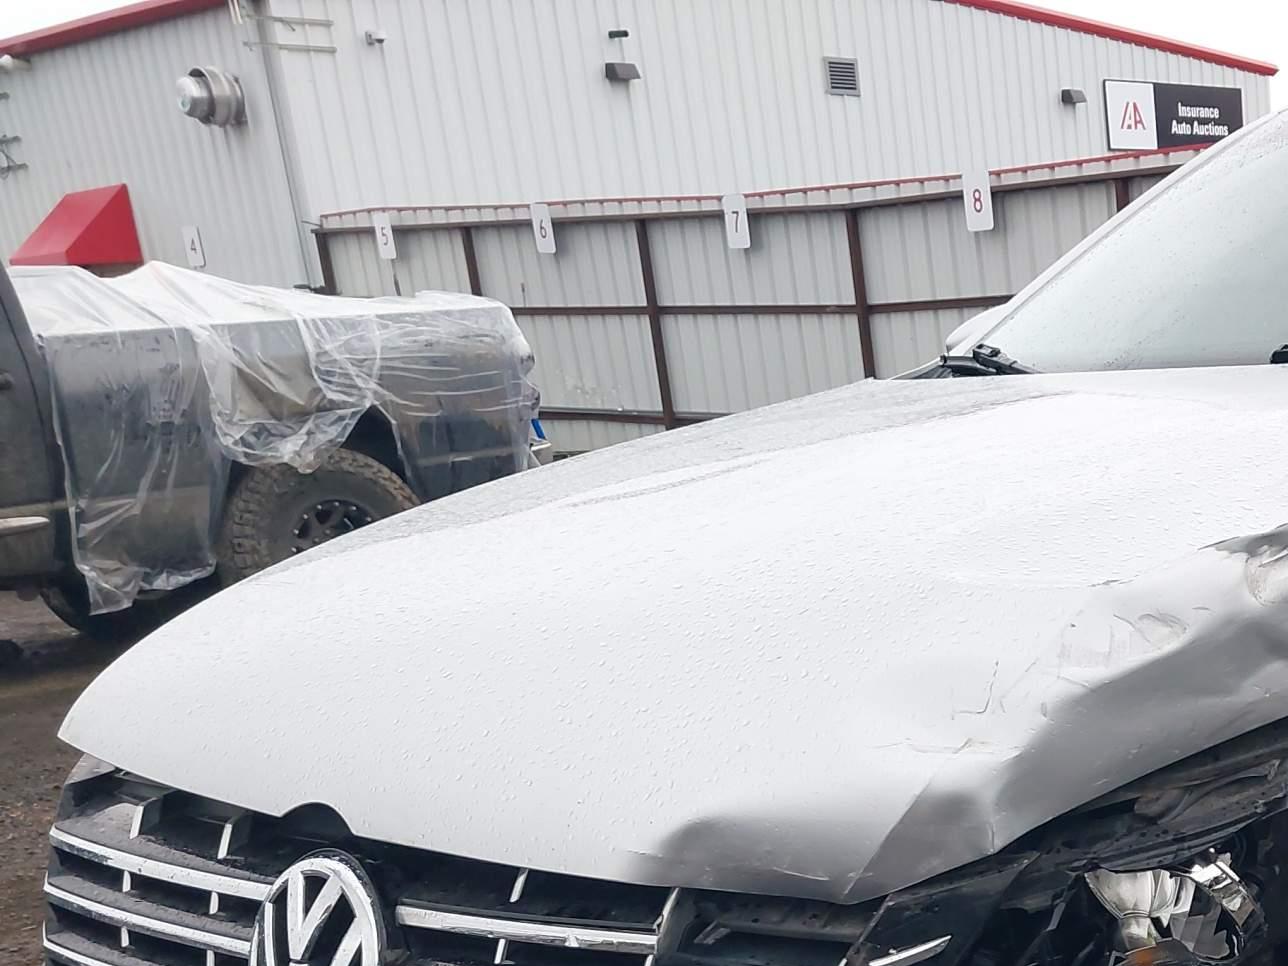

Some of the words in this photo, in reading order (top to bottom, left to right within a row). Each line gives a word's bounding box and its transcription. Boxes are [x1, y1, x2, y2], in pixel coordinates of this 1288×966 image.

[1178, 102, 1219, 118] Insurance
[1171, 120, 1192, 135] Auto
[1193, 121, 1229, 136] Auctions
[972, 189, 983, 213] 8
[538, 216, 548, 240] 6
[730, 209, 741, 234] 7
[189, 237, 198, 255] 4
[380, 226, 390, 247] 5
